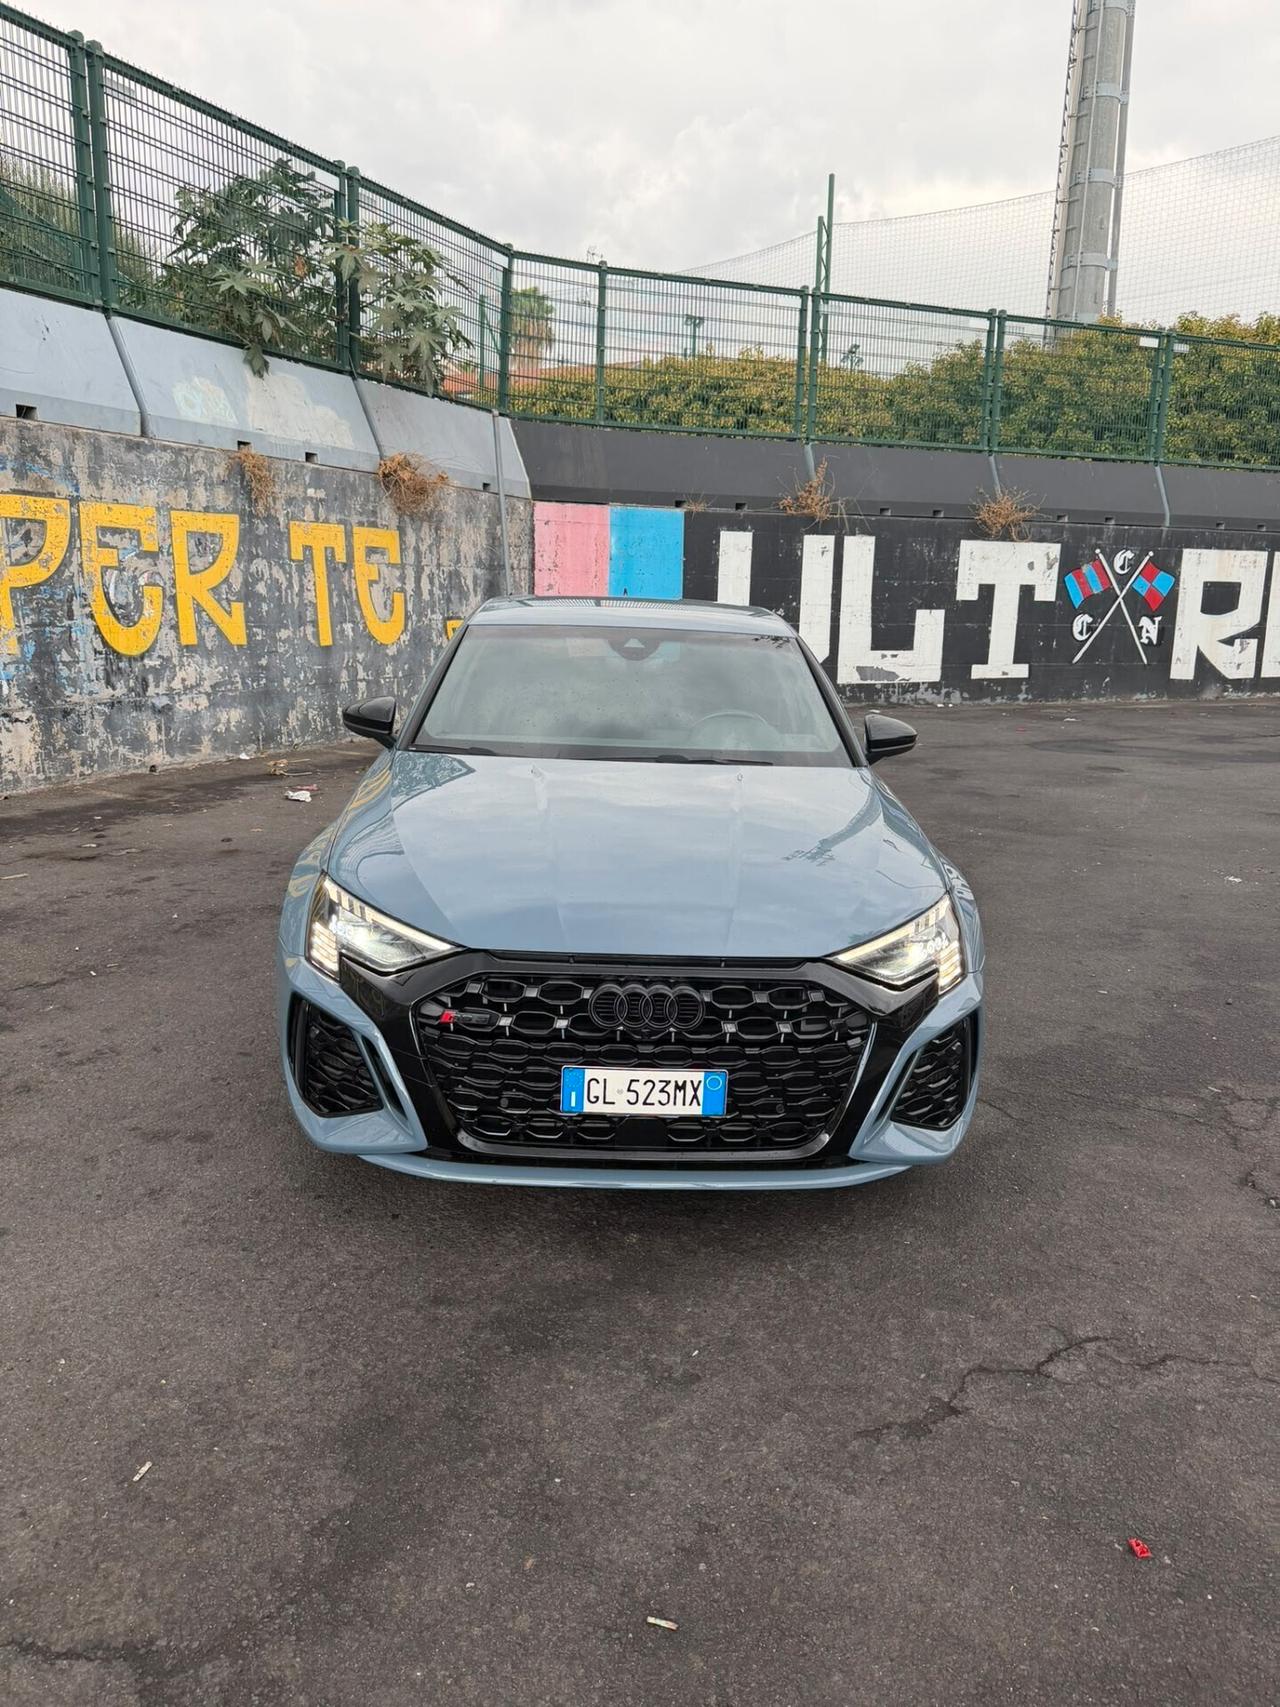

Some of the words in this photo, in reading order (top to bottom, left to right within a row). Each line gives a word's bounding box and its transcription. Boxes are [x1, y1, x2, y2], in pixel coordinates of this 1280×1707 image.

[289, 521, 405, 646] TE
[586, 1078, 616, 1105] GL
[626, 1079, 703, 1107] 523MX
